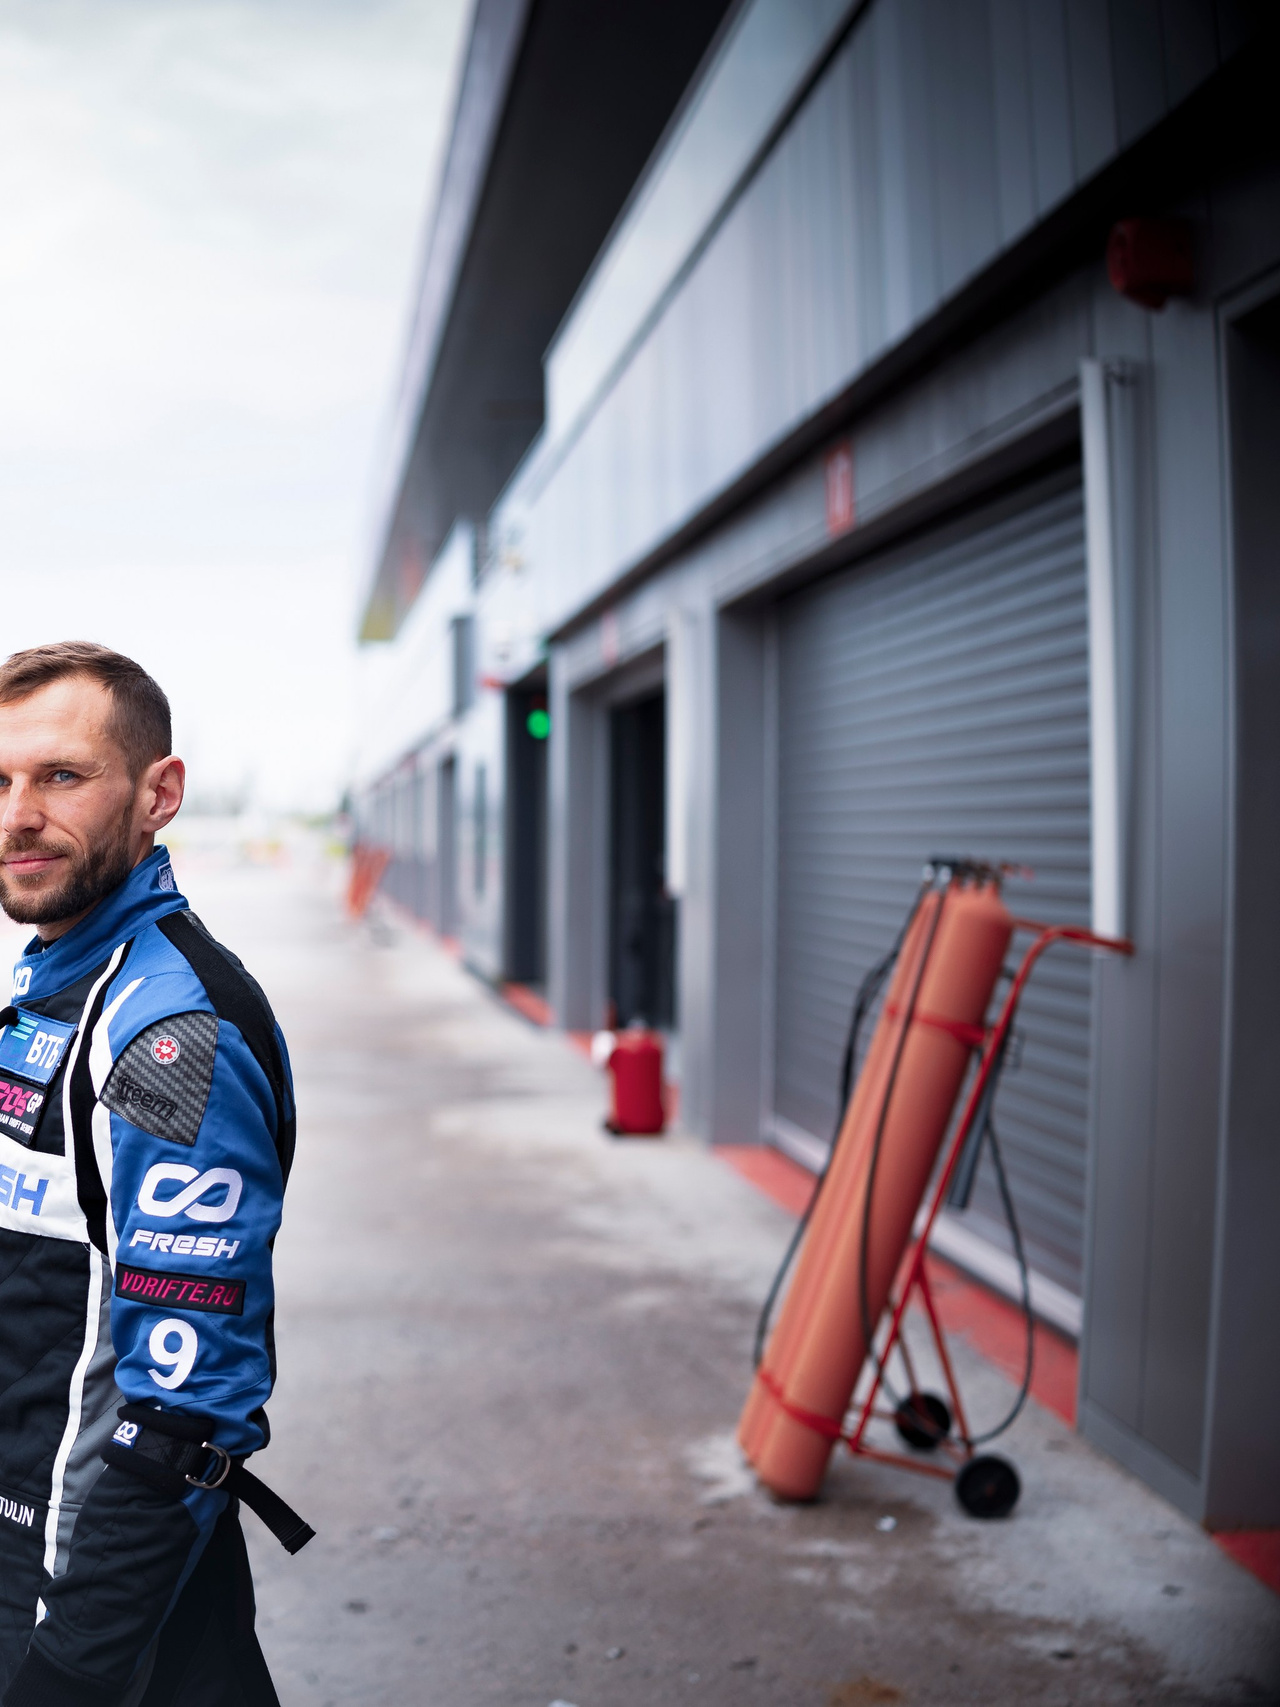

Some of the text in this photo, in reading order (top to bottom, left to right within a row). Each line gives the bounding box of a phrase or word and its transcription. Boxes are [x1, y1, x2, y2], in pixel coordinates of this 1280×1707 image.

[25, 1030, 65, 1069] ВТБ
[26, 1092, 44, 1114] GP
[120, 1271, 240, 1307] VDRIFTE.RU
[147, 1318, 198, 1390] 9
